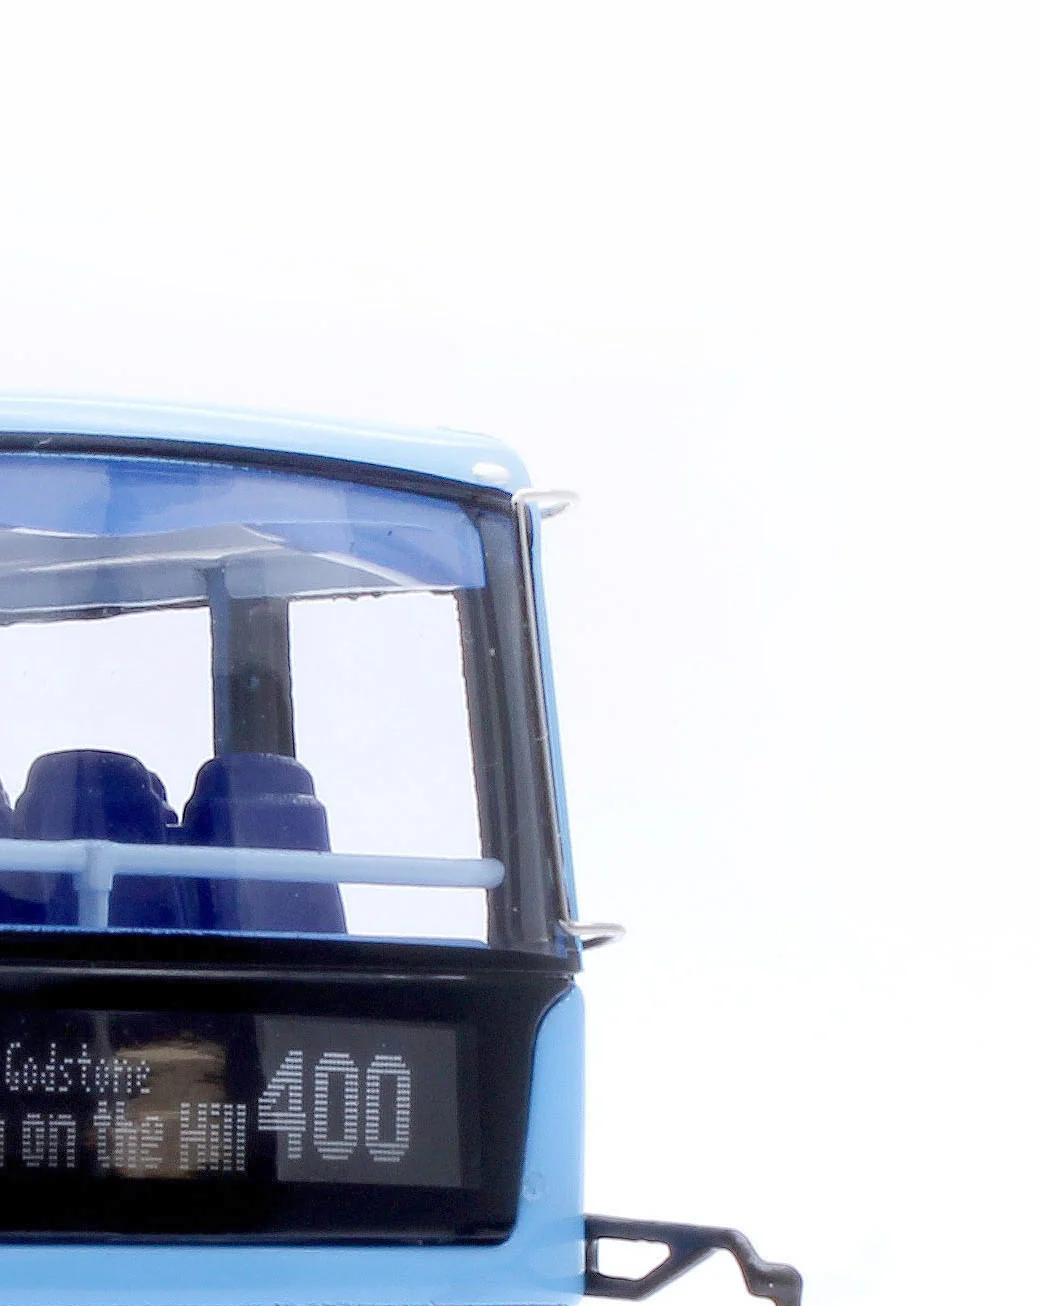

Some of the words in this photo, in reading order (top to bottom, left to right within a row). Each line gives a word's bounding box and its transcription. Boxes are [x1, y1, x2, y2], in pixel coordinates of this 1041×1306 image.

[4, 1040, 152, 1095] Godstone
[21, 1112, 77, 1169] on
[92, 1099, 164, 1170] the
[179, 1101, 247, 1172] Hill
[257, 1050, 412, 1163] 400
